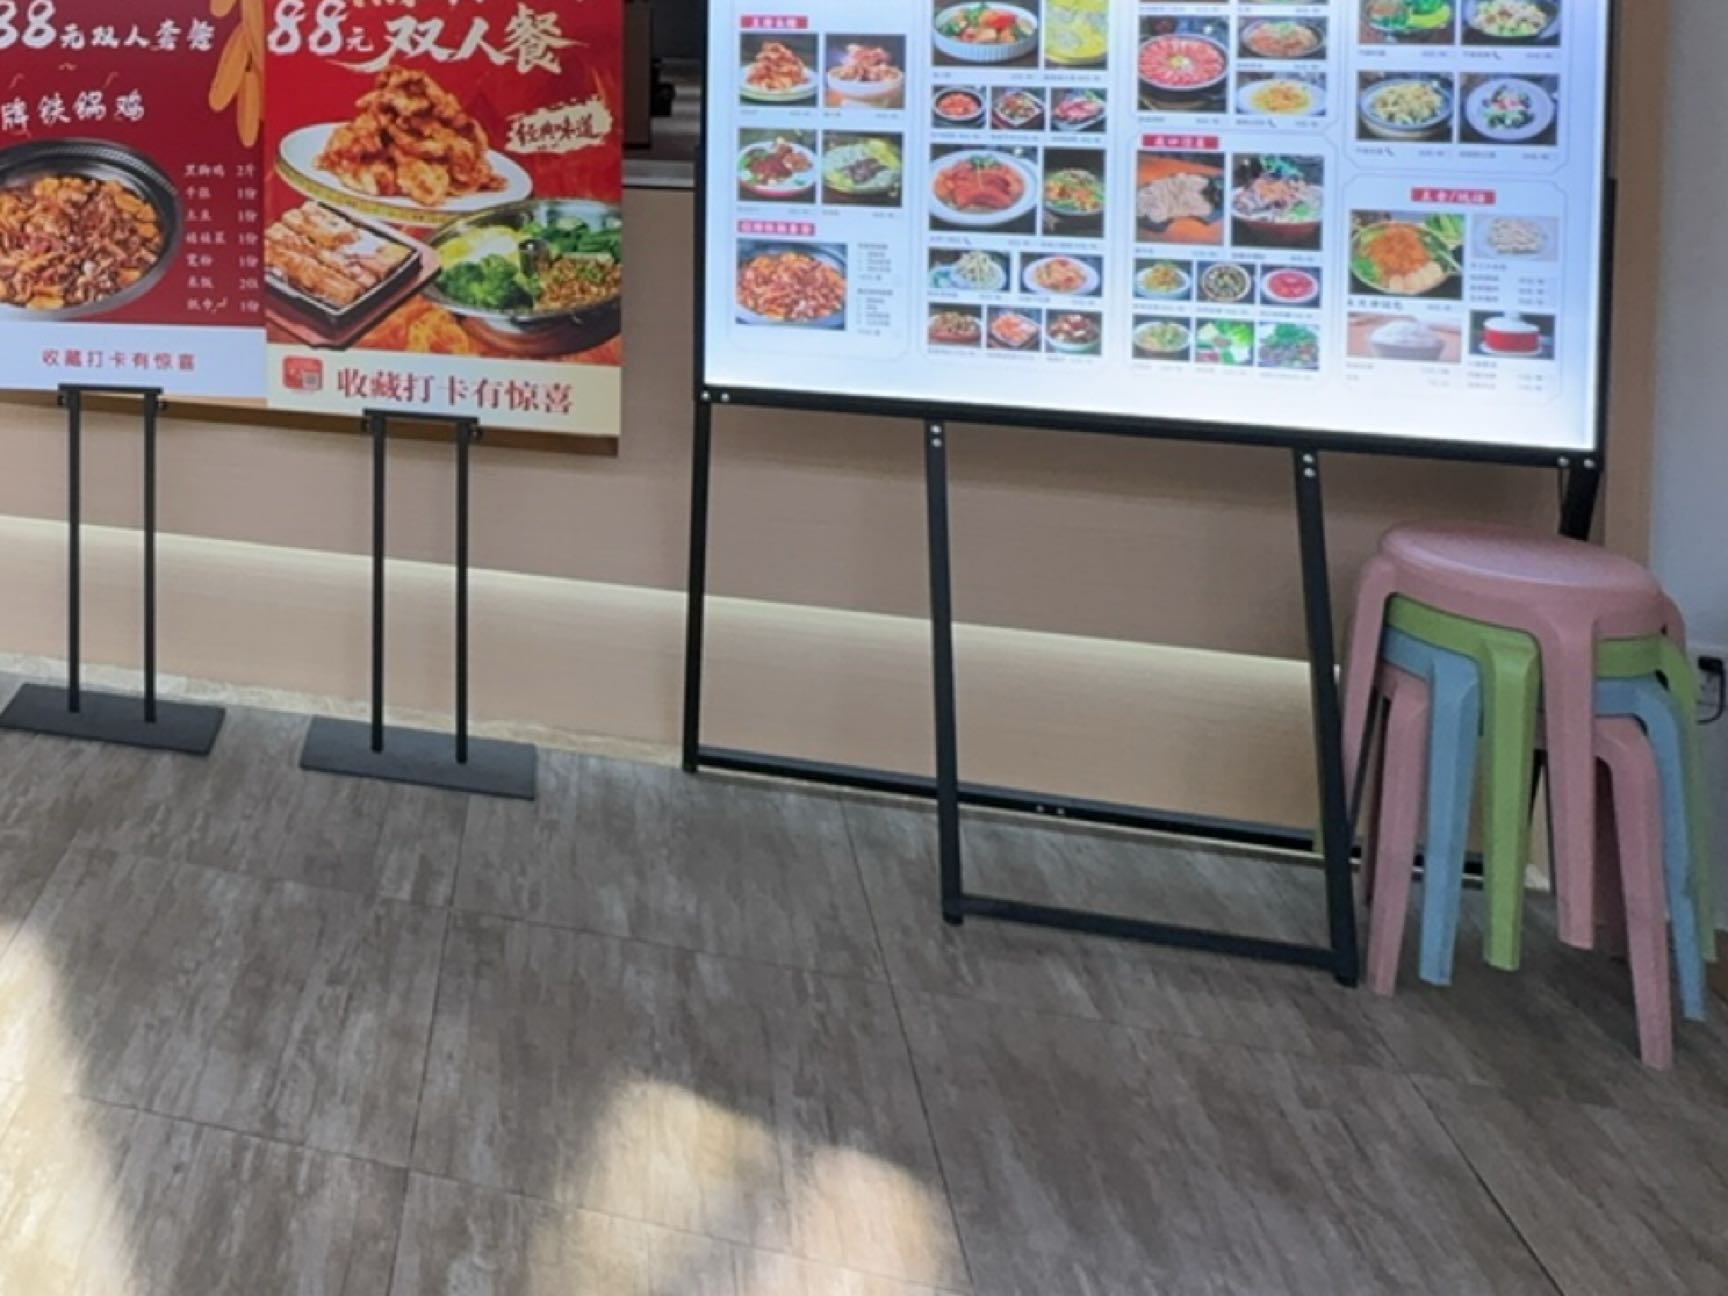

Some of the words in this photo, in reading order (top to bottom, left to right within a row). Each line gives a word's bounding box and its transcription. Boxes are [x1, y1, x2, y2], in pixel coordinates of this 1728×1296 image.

[42, 349, 196, 372] 收藏打卡有惊喜
[336, 367, 574, 414] 收藏打卡有惊喜
